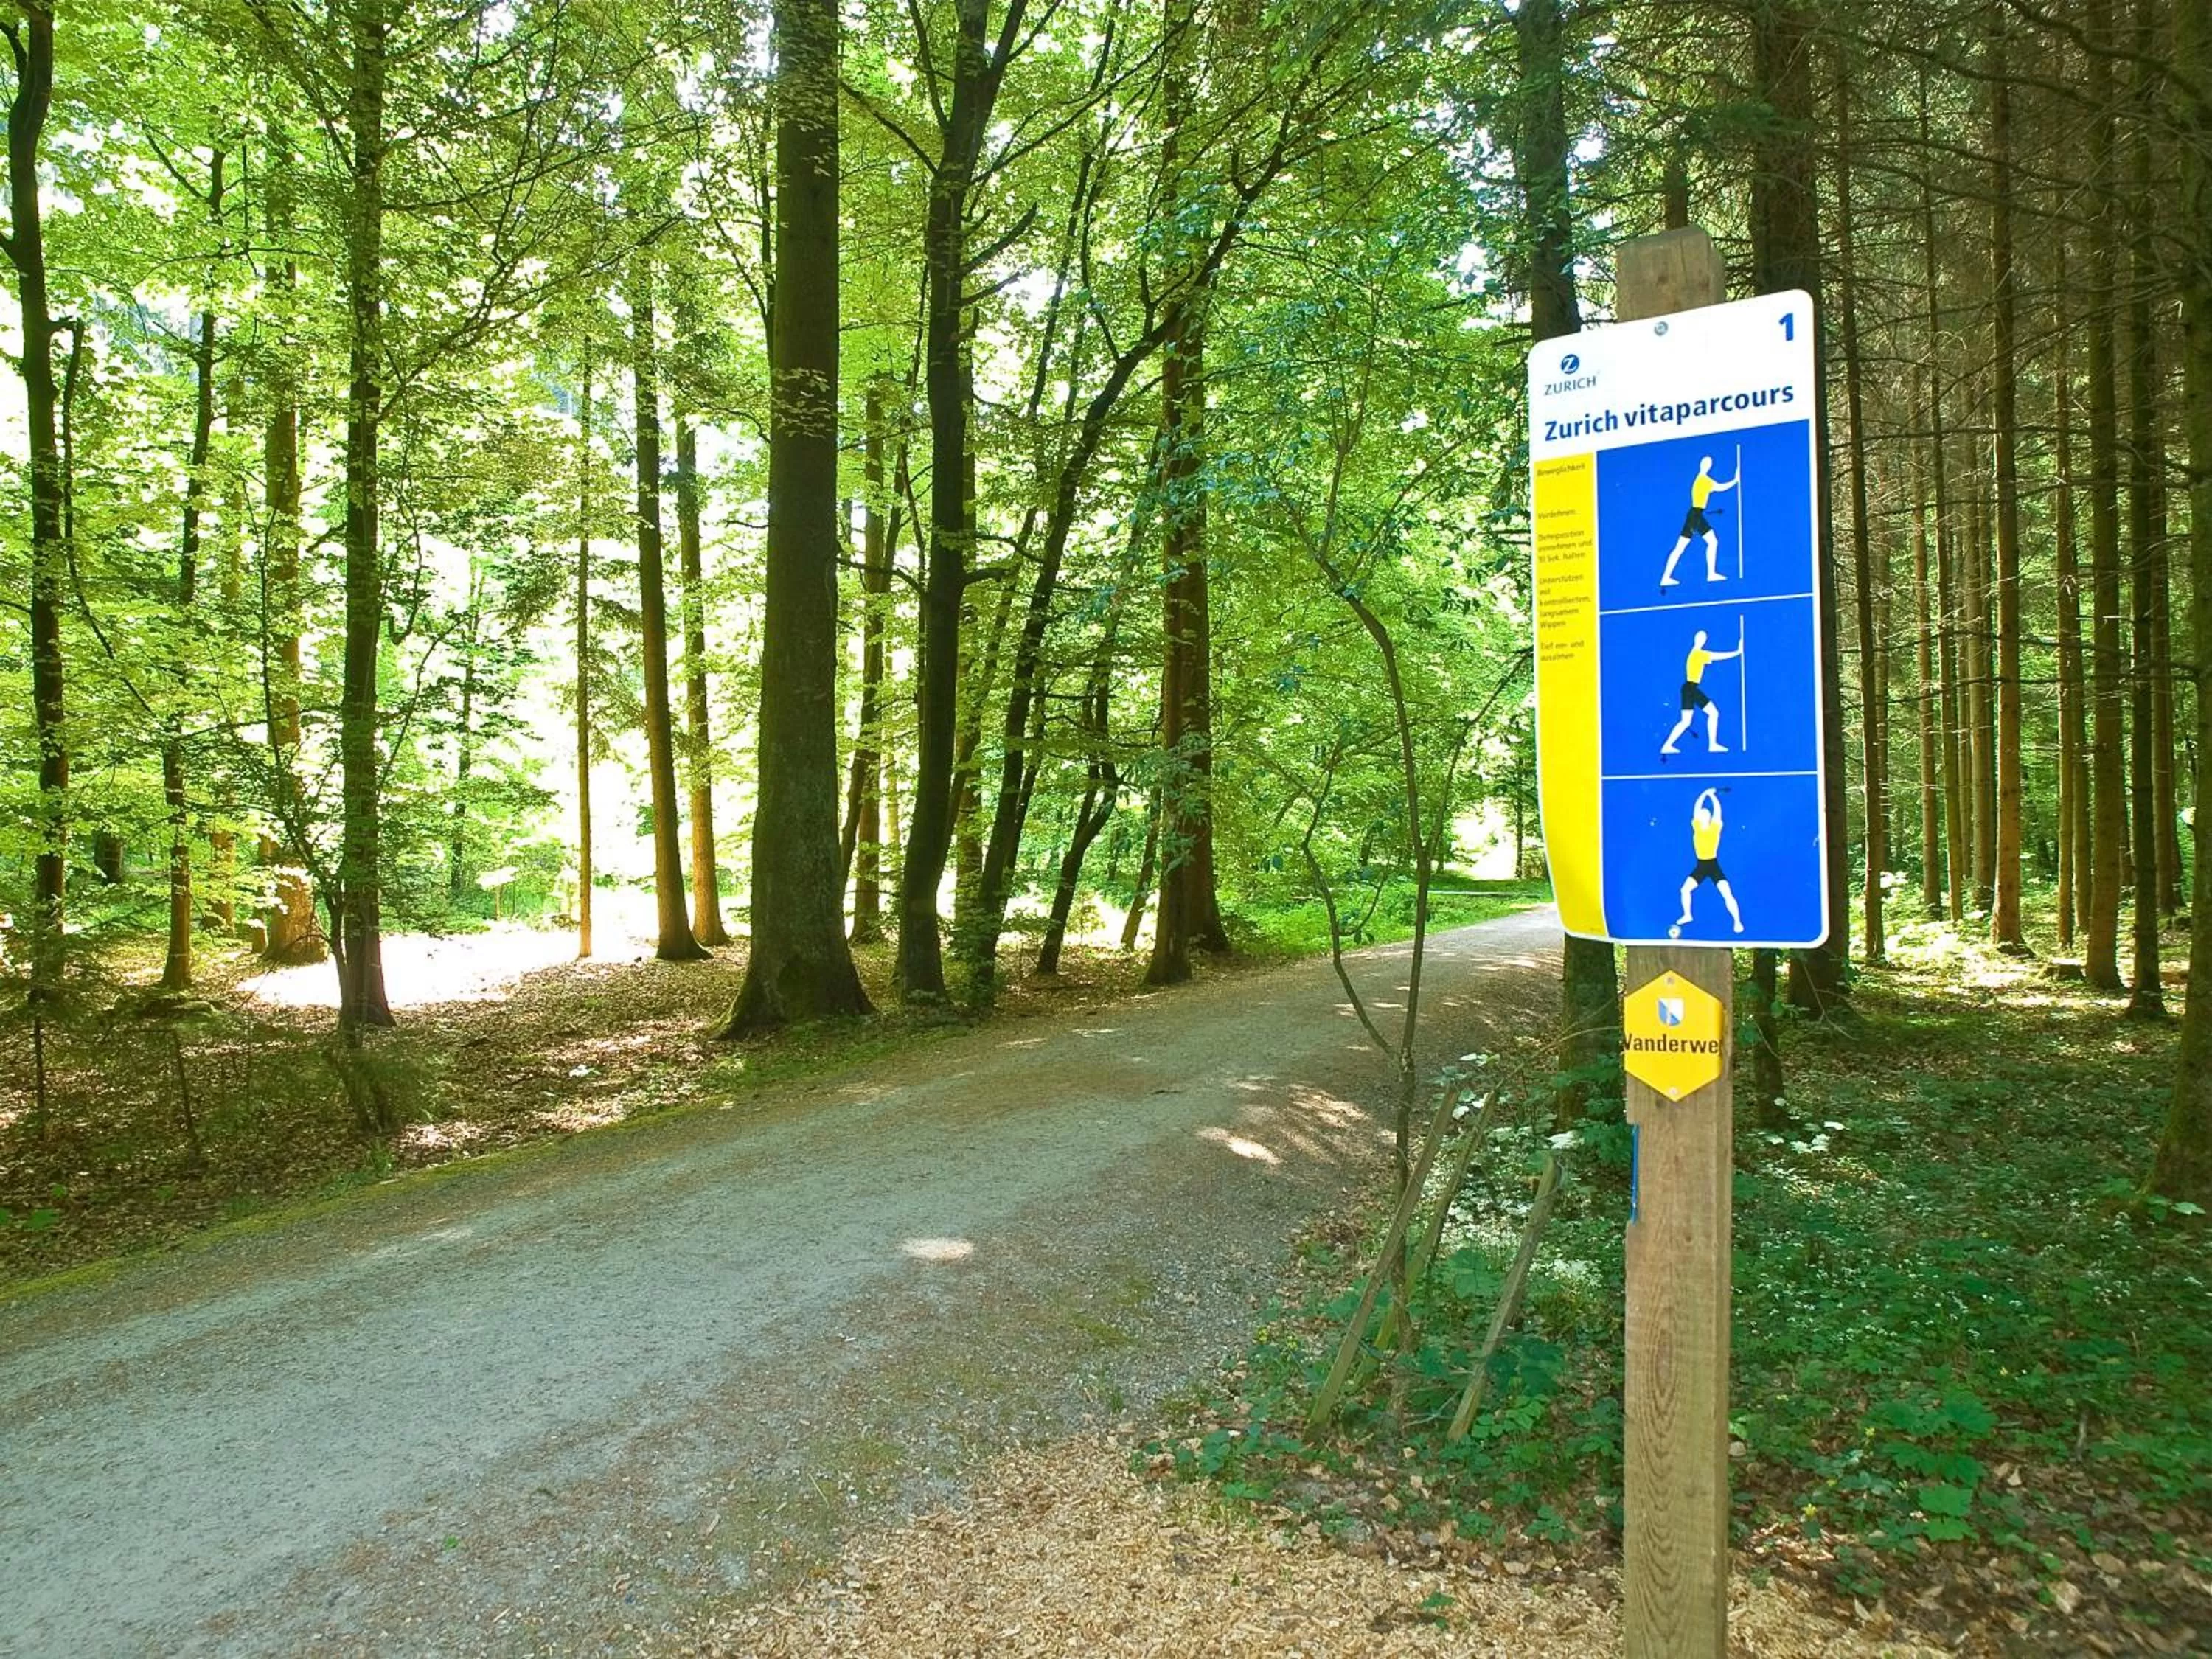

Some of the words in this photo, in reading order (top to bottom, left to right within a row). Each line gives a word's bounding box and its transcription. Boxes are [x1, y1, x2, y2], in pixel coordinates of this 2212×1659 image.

[1778, 312, 1795, 341] 1
[1544, 375, 1596, 396] ZURICH
[1545, 409, 1618, 441] Zurich
[1624, 384, 1794, 425] vitaparcours
[1624, 1033, 1722, 1054] anderwe
